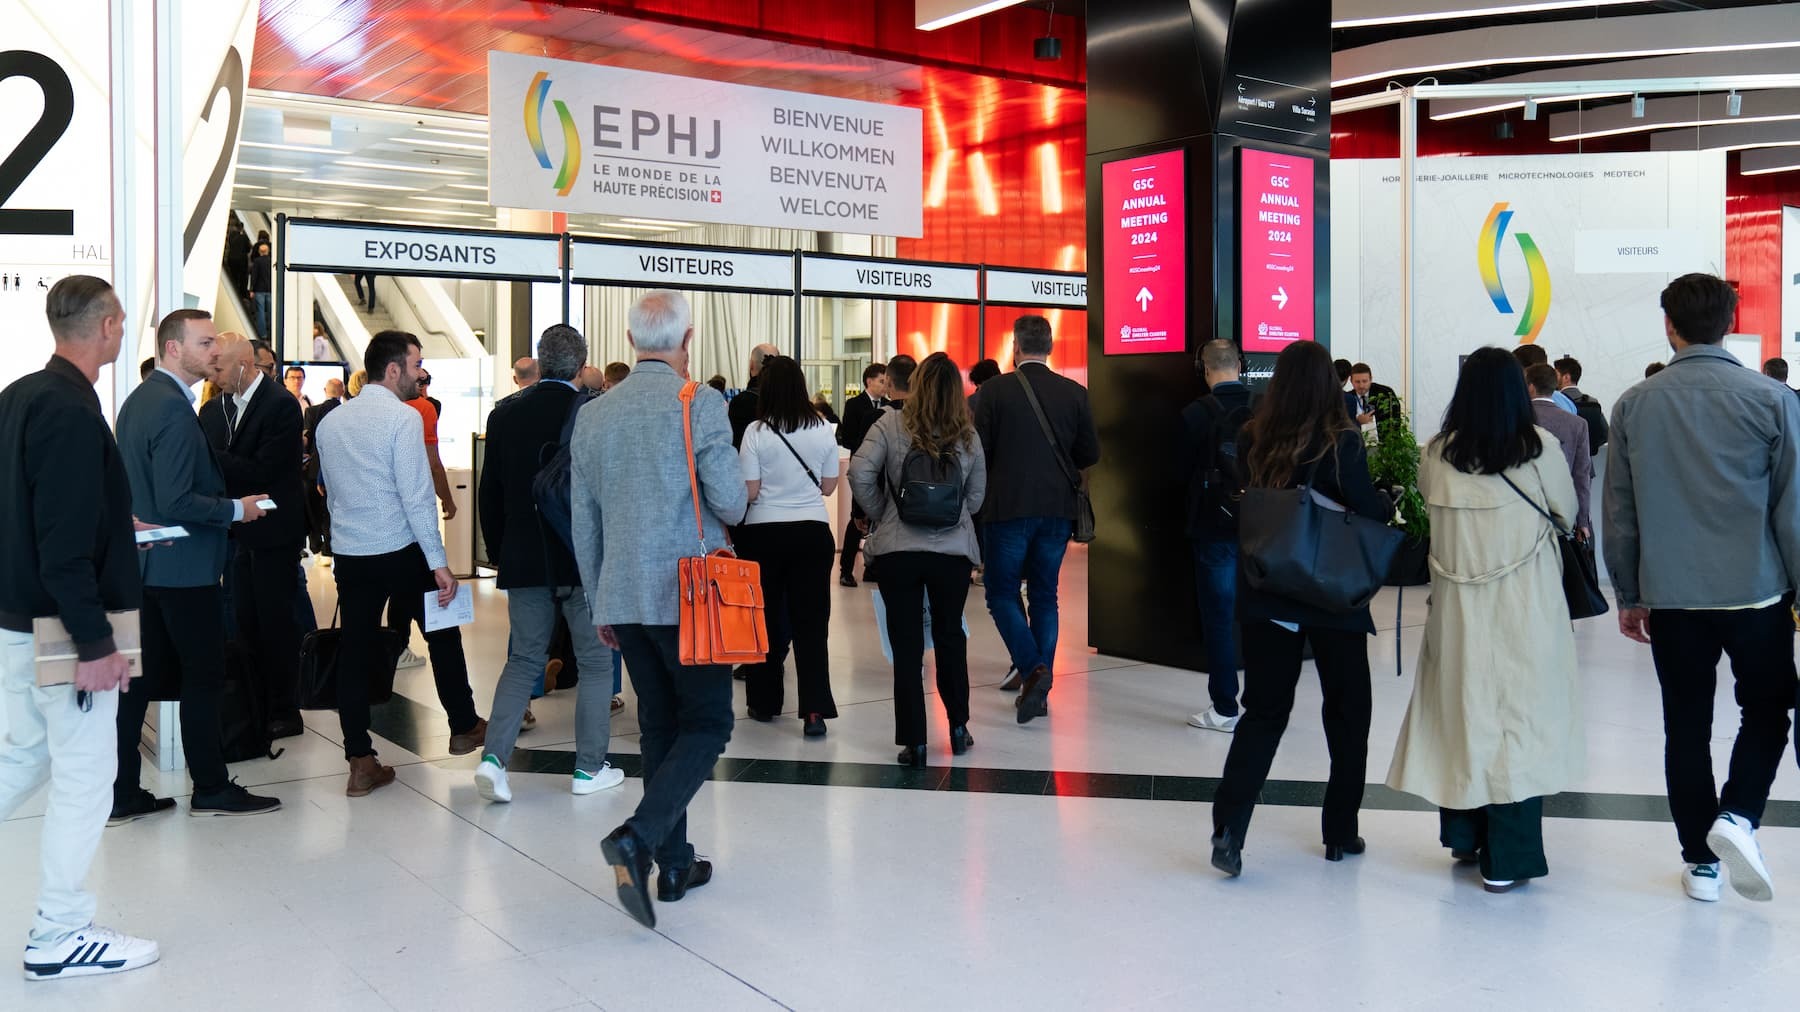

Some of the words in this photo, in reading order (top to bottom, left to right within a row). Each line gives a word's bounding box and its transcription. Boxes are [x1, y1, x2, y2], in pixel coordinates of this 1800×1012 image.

[593, 104, 721, 160] EPHJ
[773, 107, 884, 137] BIENVENUE
[0, 50, 74, 235] 2
[761, 135, 894, 166] WILLKOMMEN
[593, 163, 611, 176] LE
[618, 166, 672, 181] MONDE
[679, 172, 698, 184] DE
[704, 174, 721, 186] LA
[770, 165, 887, 193] BENVENUTA
[1133, 178, 1154, 191] GSC
[1270, 175, 1290, 189] GSC
[1498, 171, 1594, 180] MICROTECHNOLOGIES
[1603, 170, 1646, 178] MEDTECH
[593, 180, 637, 196] HAUTE
[640, 183, 709, 202] PRÉCISION
[1260, 192, 1300, 208] ANNUAL
[779, 196, 880, 221] WELCOME
[1122, 194, 1167, 211] ANNUAL
[1120, 212, 1168, 229] MEETING
[1258, 210, 1301, 226] MEETING
[1131, 231, 1158, 245] 2024
[1268, 229, 1292, 243] 2024
[364, 239, 497, 265] EXPOSANTS
[1617, 247, 1659, 256] VISITEURS
[639, 255, 735, 277] VISITEURS
[856, 268, 933, 288] VISITEURS
